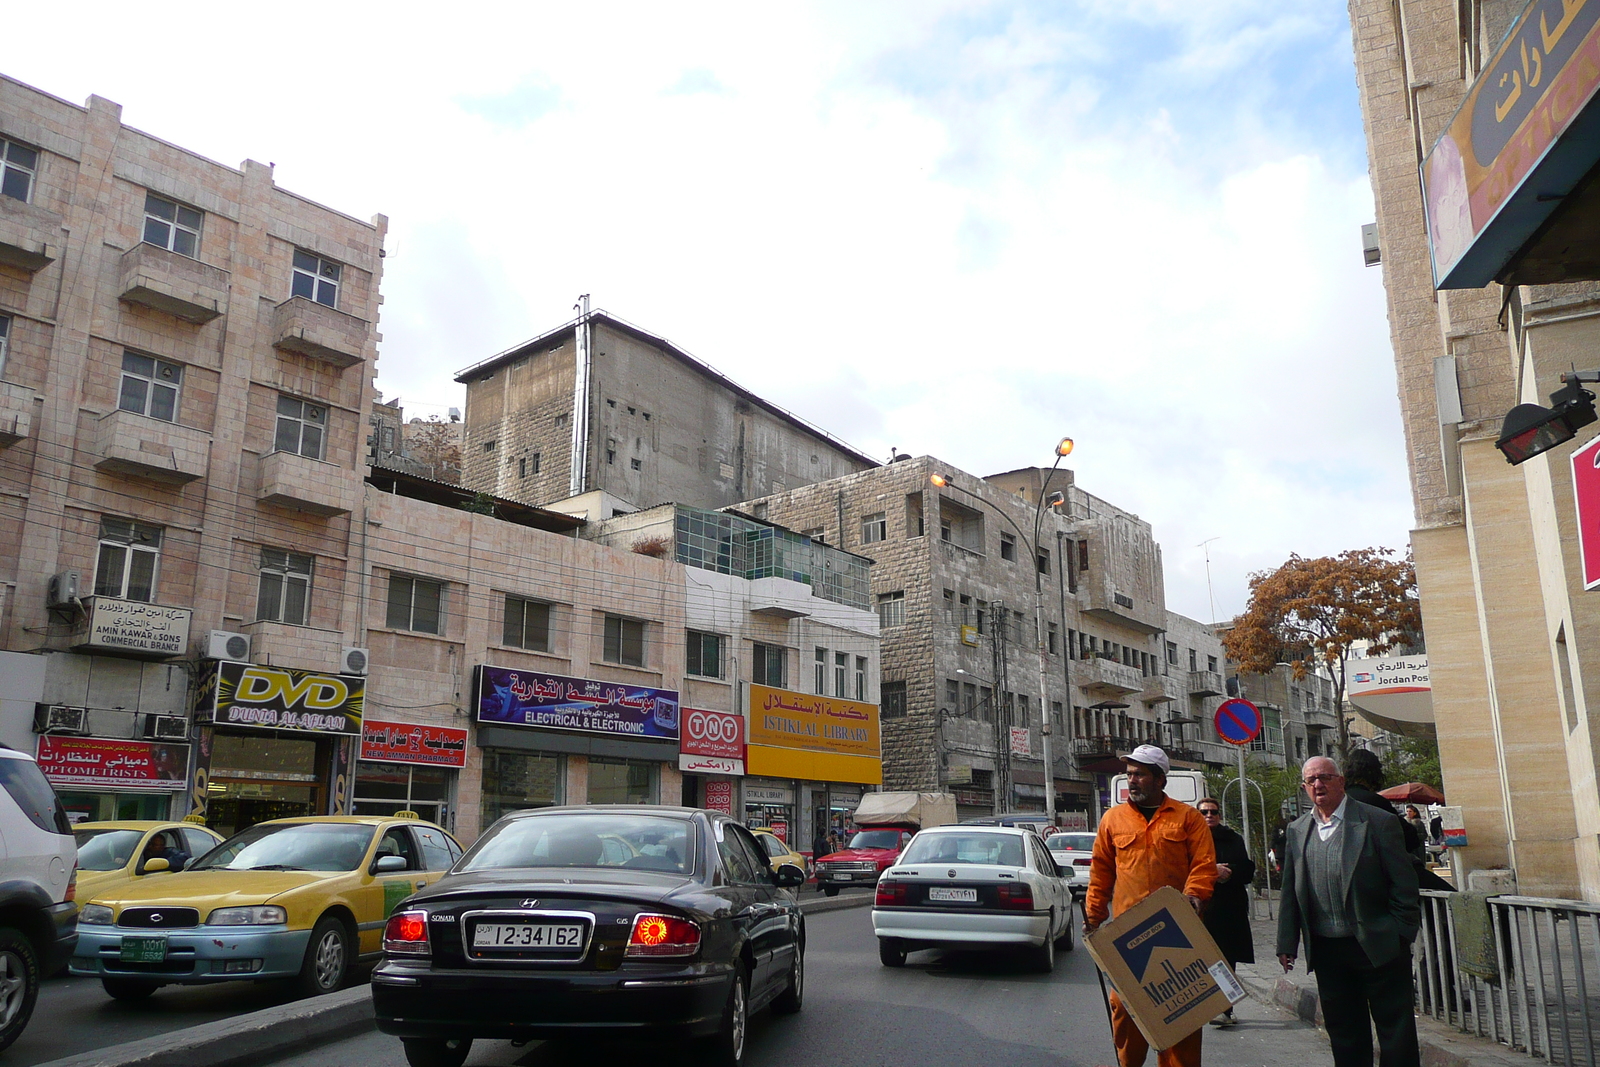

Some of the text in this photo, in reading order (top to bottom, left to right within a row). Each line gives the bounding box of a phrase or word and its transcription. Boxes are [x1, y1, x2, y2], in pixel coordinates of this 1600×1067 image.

[1486, 34, 1600, 207] OPTICA
[112, 617, 146, 628] التجاري
[165, 610, 185, 620] شركة
[96, 626, 119, 636] AMIN
[120, 628, 152, 640] KAWAR
[158, 633, 181, 643] SONS
[102, 634, 179, 652] COMMERCIAL BRANCH
[1406, 660, 1429, 670] لبريد
[235, 667, 348, 709] DVD
[510, 674, 563, 702] التجارية
[1378, 674, 1430, 684] Jordan Pos
[618, 687, 655, 713] مؤسسة
[763, 694, 869, 721] مكتبة الإستقلال
[228, 706, 277, 725] DUNIA
[526, 711, 644, 733] ELECTRICAL & ELECTRONIC
[364, 726, 390, 748] الجديدة
[688, 712, 738, 743] TNT
[764, 715, 820, 737] ISTIKLAL
[824, 724, 869, 742] LIBRARY
[424, 730, 465, 754] صيدلية
[40, 748, 149, 768] دمياني للنظارات
[386, 752, 416, 760] AMMAN
[418, 754, 459, 763] PHARMACY
[688, 760, 735, 772] أرامكس
[40, 764, 148, 778] OPTOMETRISTS
[1151, 922, 1162, 934] BOX
[1142, 958, 1208, 1008] Marlboro
[1165, 980, 1208, 1012] LIGHTS
